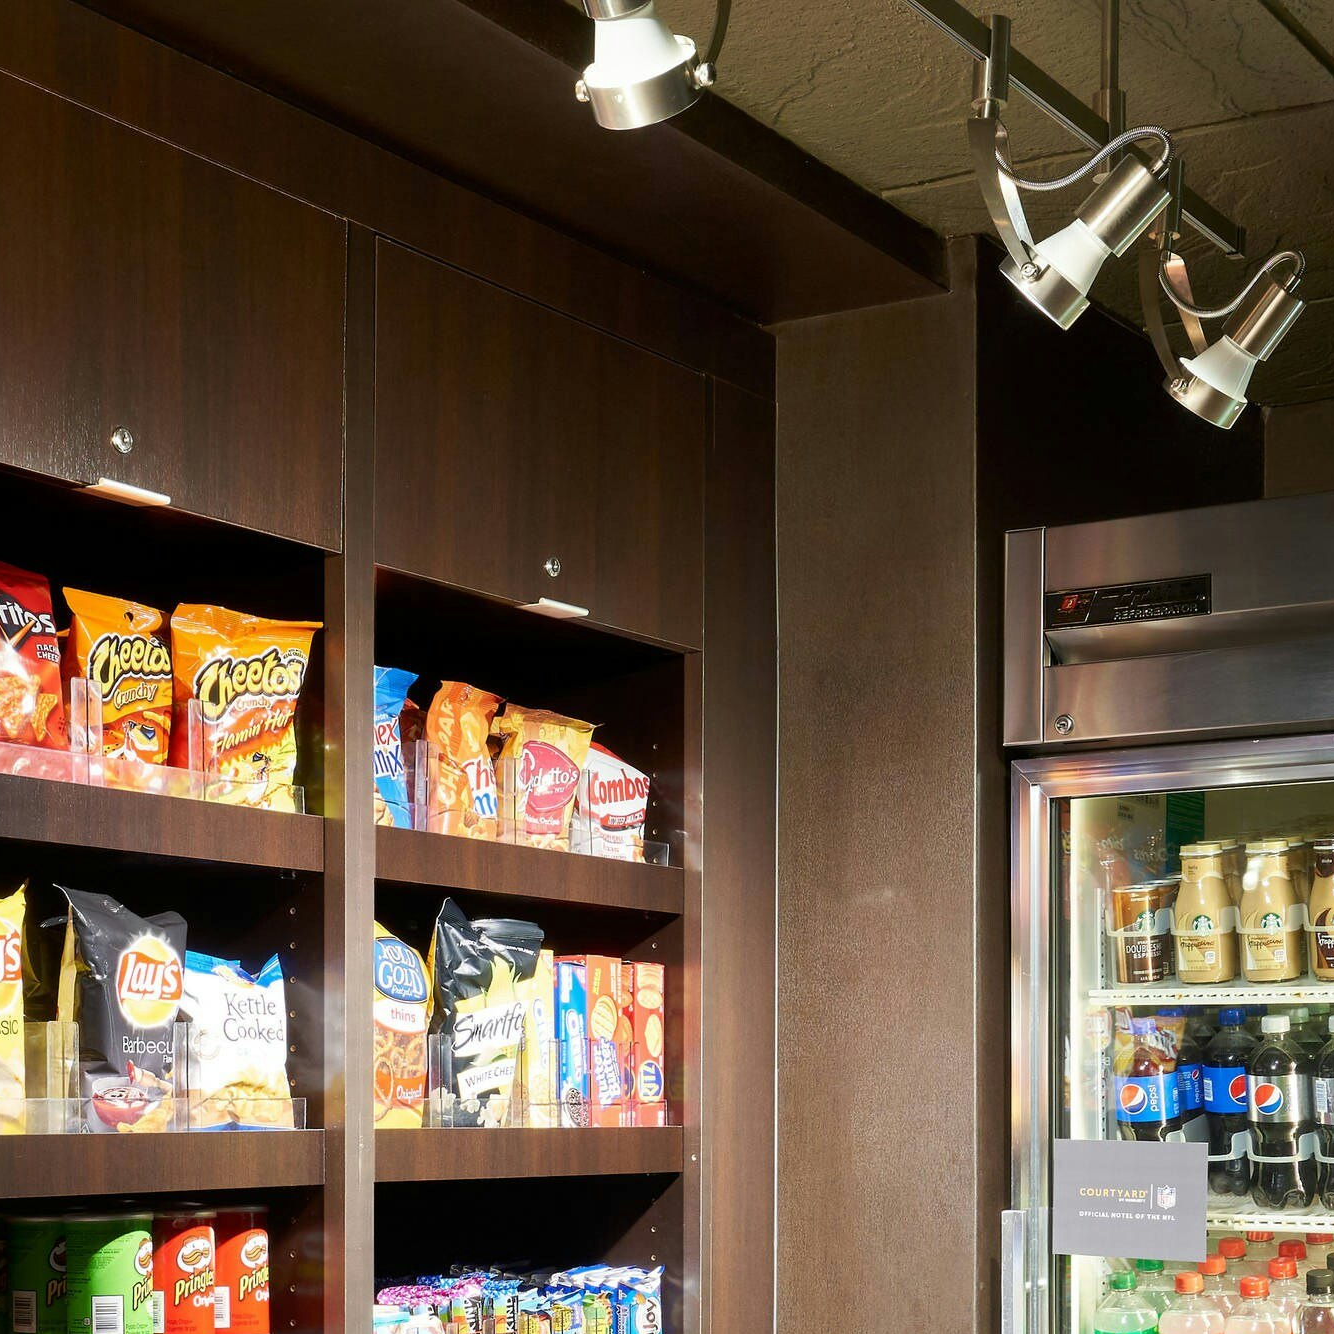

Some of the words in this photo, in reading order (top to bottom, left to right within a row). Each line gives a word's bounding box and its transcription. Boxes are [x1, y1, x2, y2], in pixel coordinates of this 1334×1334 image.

[1114, 603, 1199, 621] REFRIGERATOR
[88, 635, 172, 688] Cheetos
[113, 682, 157, 710] Crunchy
[194, 648, 304, 721] Cheetos
[264, 708, 295, 733] Hot
[589, 768, 650, 806] Combos
[380, 942, 416, 963] ROLD
[120, 952, 179, 1000] Lay's
[378, 962, 425, 994] GOLD
[224, 992, 276, 1021] Kettle
[390, 1006, 416, 1024] thins
[223, 1018, 284, 1044] Cooked
[396, 1083, 423, 1104] Original
[642, 1063, 660, 1097] RITZ
[1150, 1084, 1160, 1112] pepsi
[1079, 1187, 1147, 1199] COURTYARD
[1079, 1210, 1109, 1218] OFFICIAL
[506, 1296, 516, 1333] KIND
